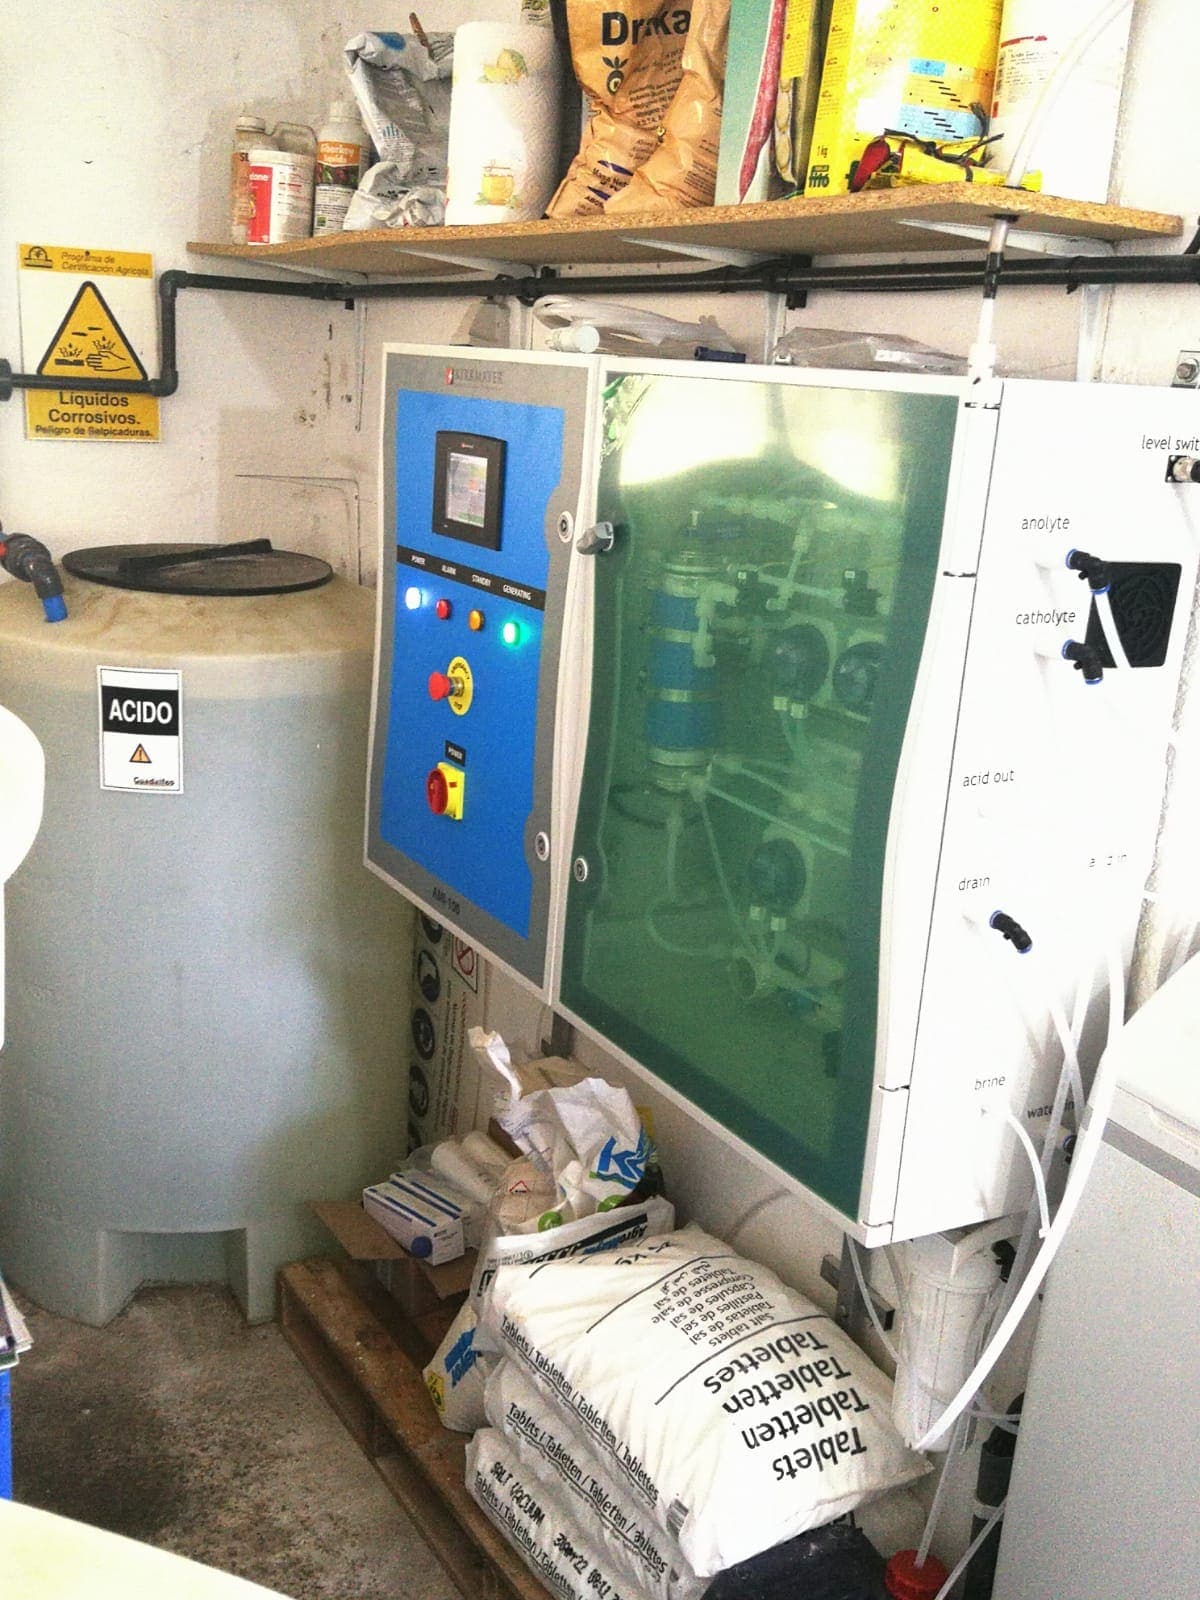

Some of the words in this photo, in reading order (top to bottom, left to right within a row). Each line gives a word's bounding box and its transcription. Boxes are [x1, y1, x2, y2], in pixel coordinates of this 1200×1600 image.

[48, 409, 141, 425] Corrosivos.
[35, 425, 71, 436] Peligro
[73, 427, 86, 435] de
[1141, 435, 1172, 450] level
[1021, 516, 1070, 533] anolyte
[502, 584, 532, 601] GENERATING
[1015, 610, 1076, 626] catholyte
[109, 699, 173, 724] ACIDO
[963, 771, 990, 787] acid
[993, 770, 1015, 784] out
[958, 877, 990, 891] drain
[974, 1076, 1006, 1091] brine
[1027, 1103, 1055, 1119] wate
[687, 1268, 737, 1288] Tabletes
[695, 1274, 754, 1298] Compresse
[672, 1286, 687, 1299] de
[705, 1282, 755, 1306] Capsules
[653, 1296, 671, 1310] sal
[677, 1296, 692, 1308] de
[688, 1303, 704, 1315] de
[716, 1292, 764, 1314] Pastilles
[651, 1306, 675, 1324] sale
[669, 1312, 687, 1328] sal
[700, 1311, 716, 1322] de
[725, 1301, 775, 1324] Tabletas
[753, 1312, 775, 1327] Salt
[681, 1319, 699, 1335] sel
[707, 1320, 724, 1333] de
[709, 1322, 750, 1347] tablets
[689, 1330, 707, 1345] sal
[703, 1331, 829, 1394] Tablettes
[722, 1356, 852, 1414] Tabletten
[502, 1314, 529, 1353] Tablets
[535, 1350, 574, 1399] Tabletten
[577, 1395, 617, 1447] Tabletten
[623, 1446, 660, 1501] Tablettes
[741, 1387, 870, 1450] Tabletten
[772, 1427, 867, 1481] Tablets
[588, 1478, 631, 1531] Tabletten
